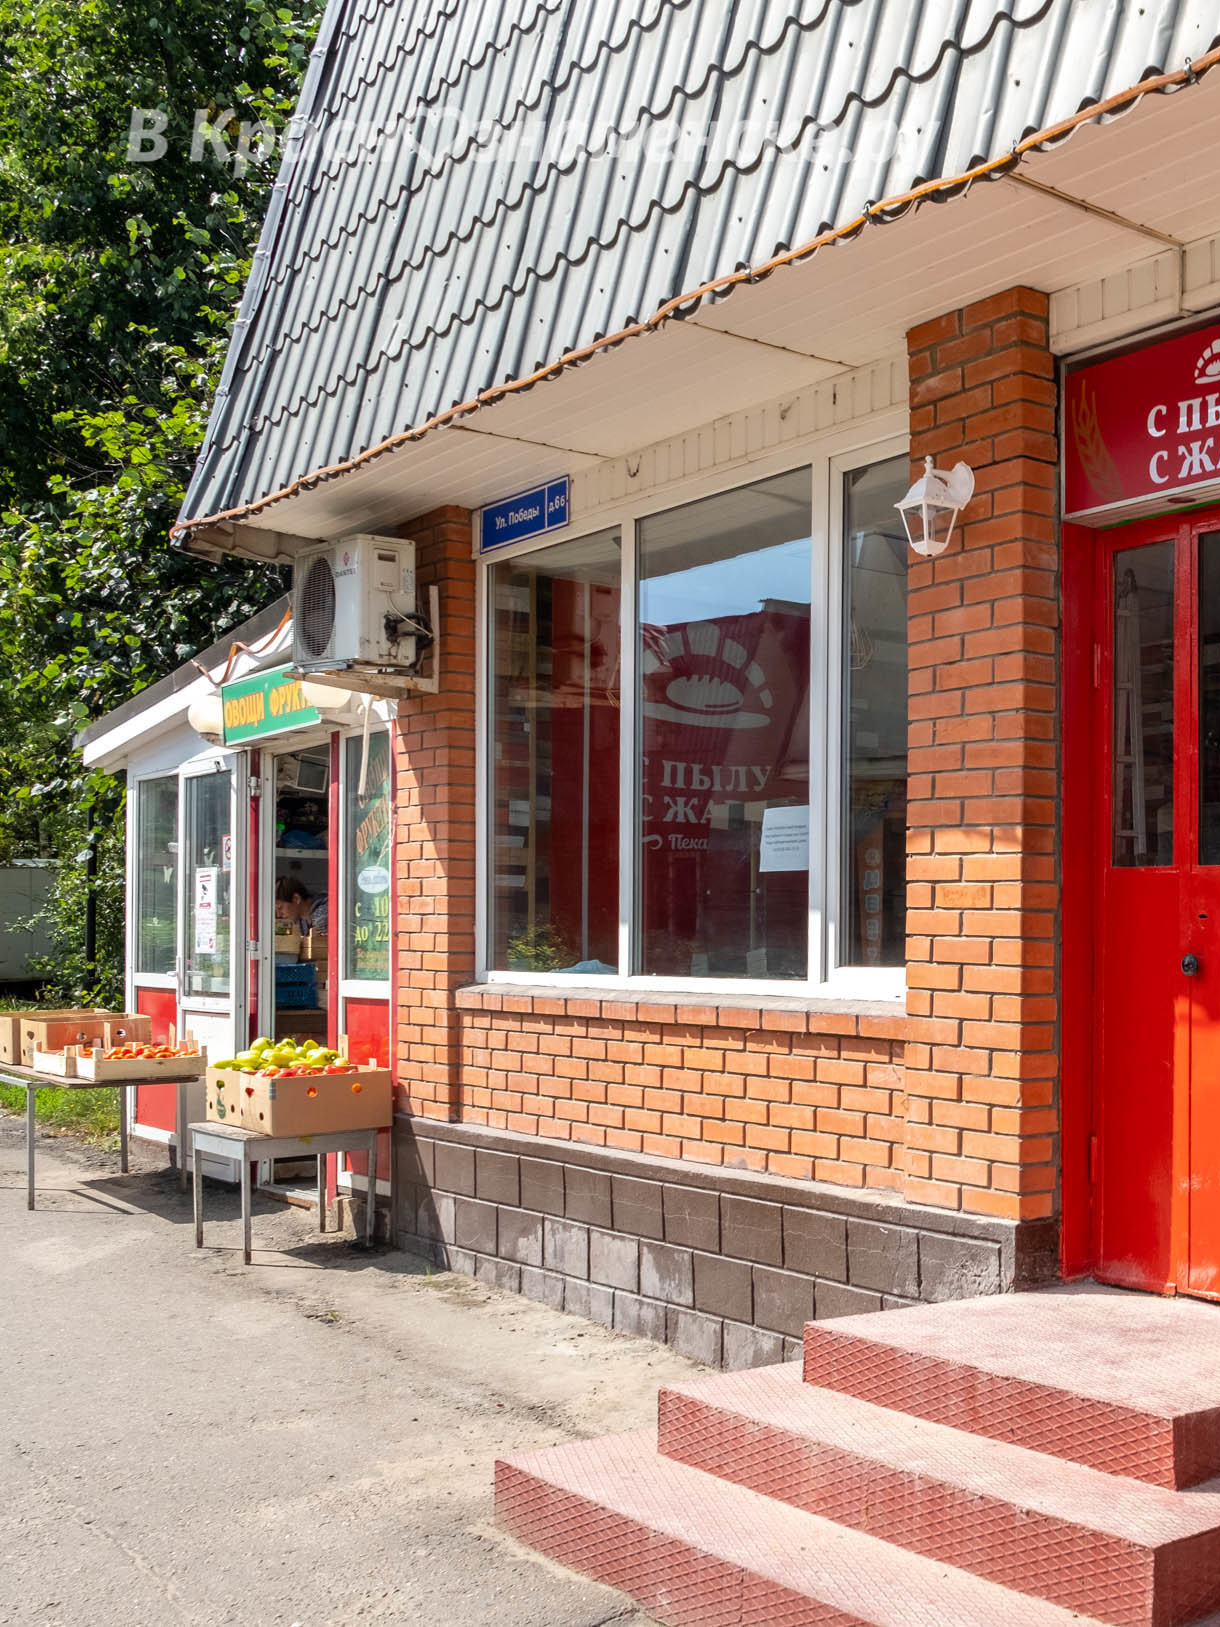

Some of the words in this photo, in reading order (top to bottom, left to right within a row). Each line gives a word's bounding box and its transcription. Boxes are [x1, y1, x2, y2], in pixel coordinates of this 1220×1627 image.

[1147, 404, 1167, 437] С
[1149, 450, 1169, 484] С
[508, 505, 540, 526] Победы
[225, 690, 265, 729] ОВОЩИ
[269, 680, 313, 718] ФРУКТ
[660, 760, 773, 792] ПЫЛУ
[662, 796, 713, 824] ЖА
[667, 833, 709, 851] Пека
